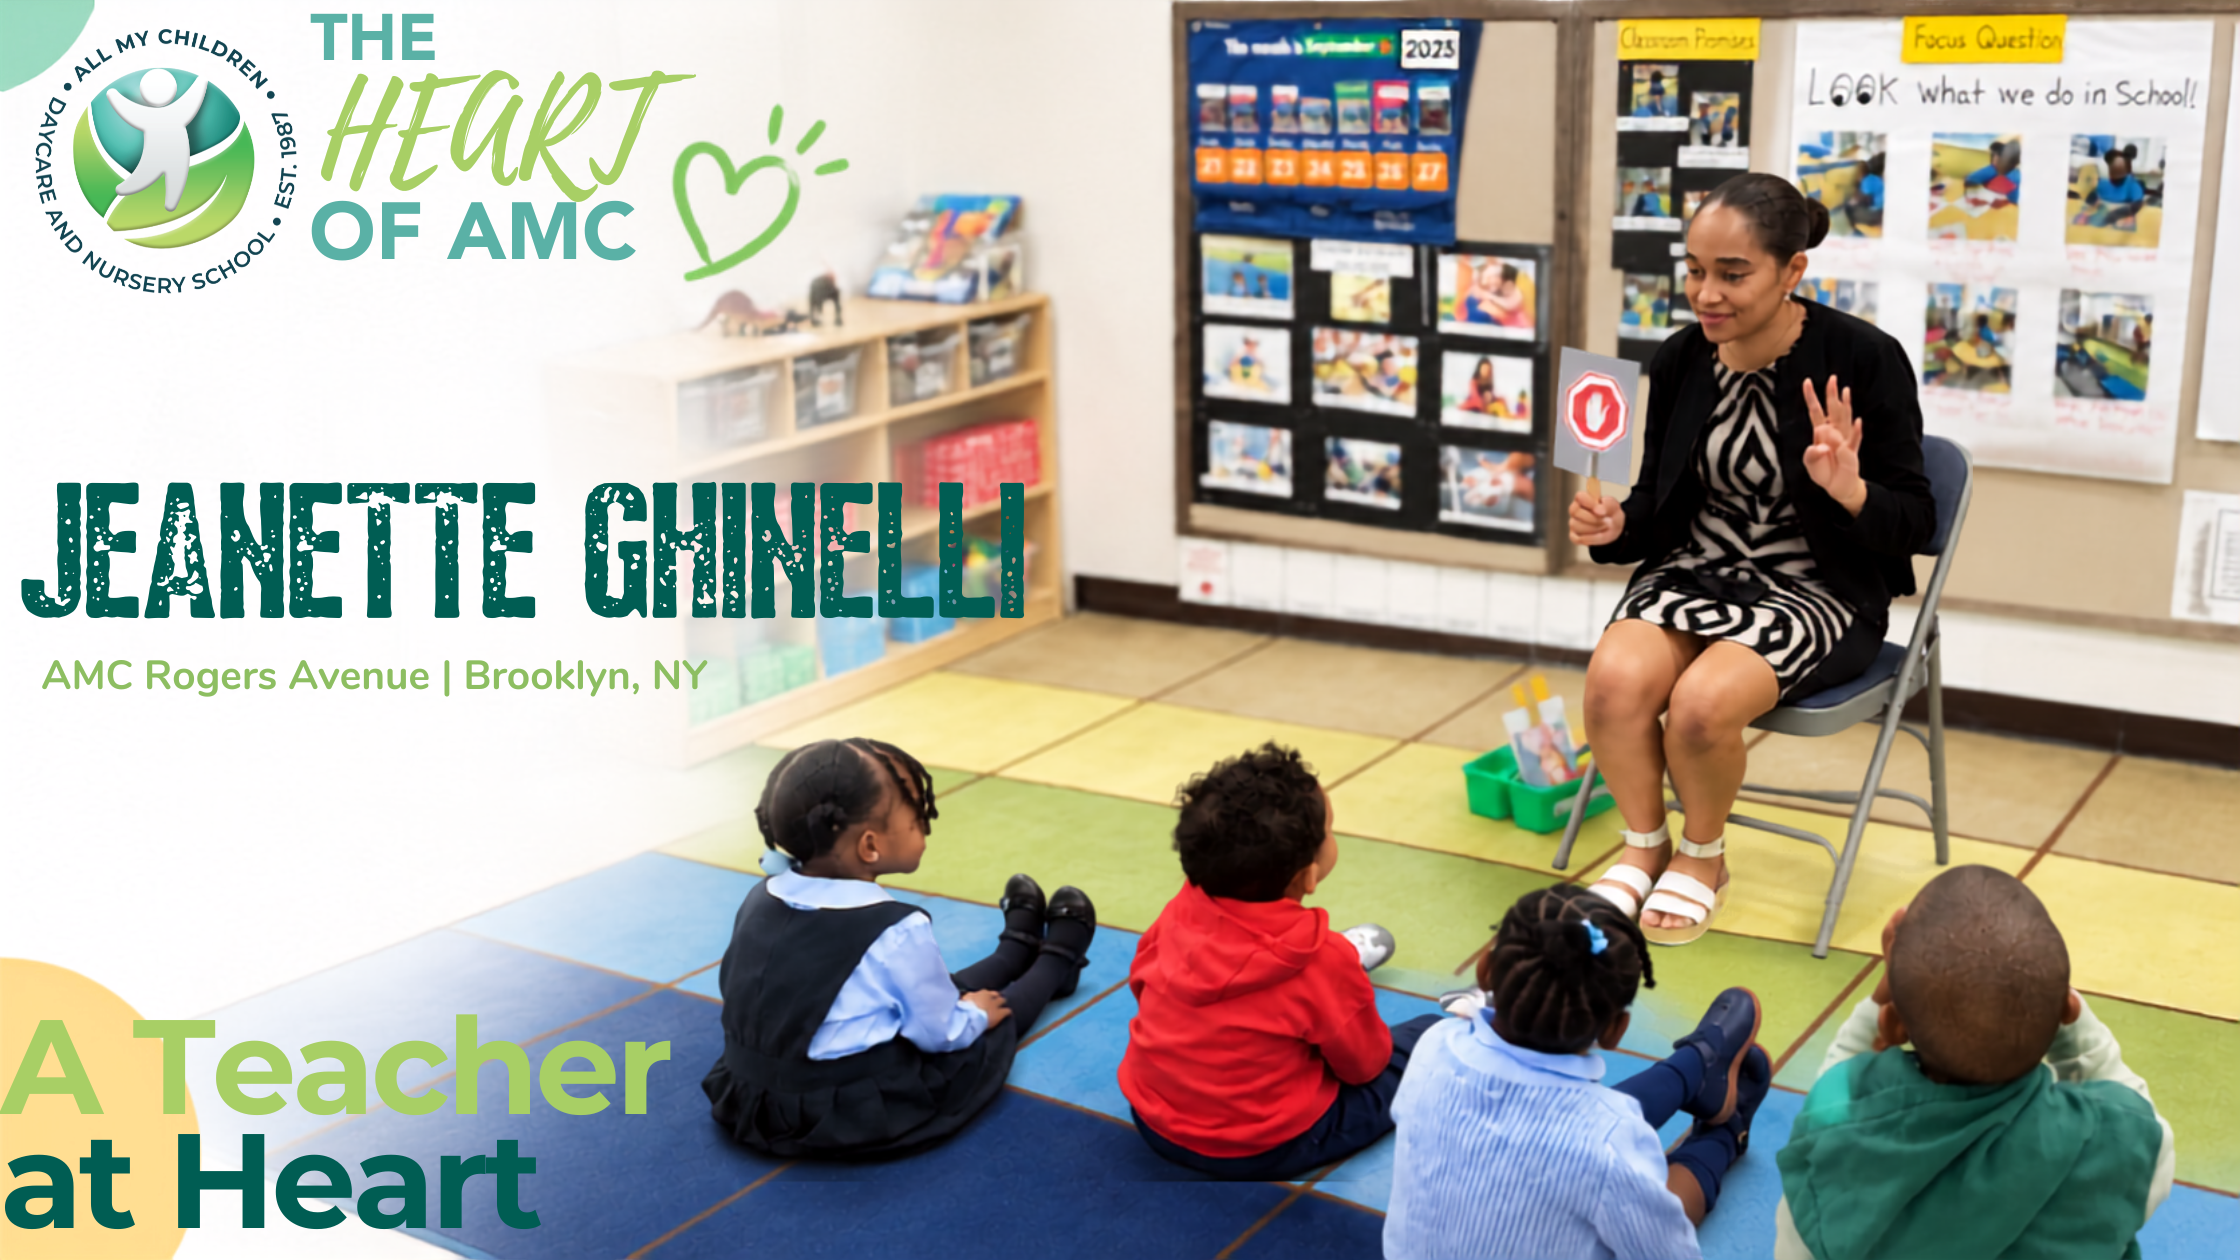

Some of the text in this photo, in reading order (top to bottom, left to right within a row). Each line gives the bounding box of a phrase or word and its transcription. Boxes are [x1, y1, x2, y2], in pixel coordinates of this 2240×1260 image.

[1914, 24, 2064, 49] Focus Question
[1918, 75, 1985, 105] what
[2000, 88, 2034, 105] we
[2046, 77, 2074, 106] do
[2085, 81, 2107, 106] in
[2116, 78, 2198, 109] School!
